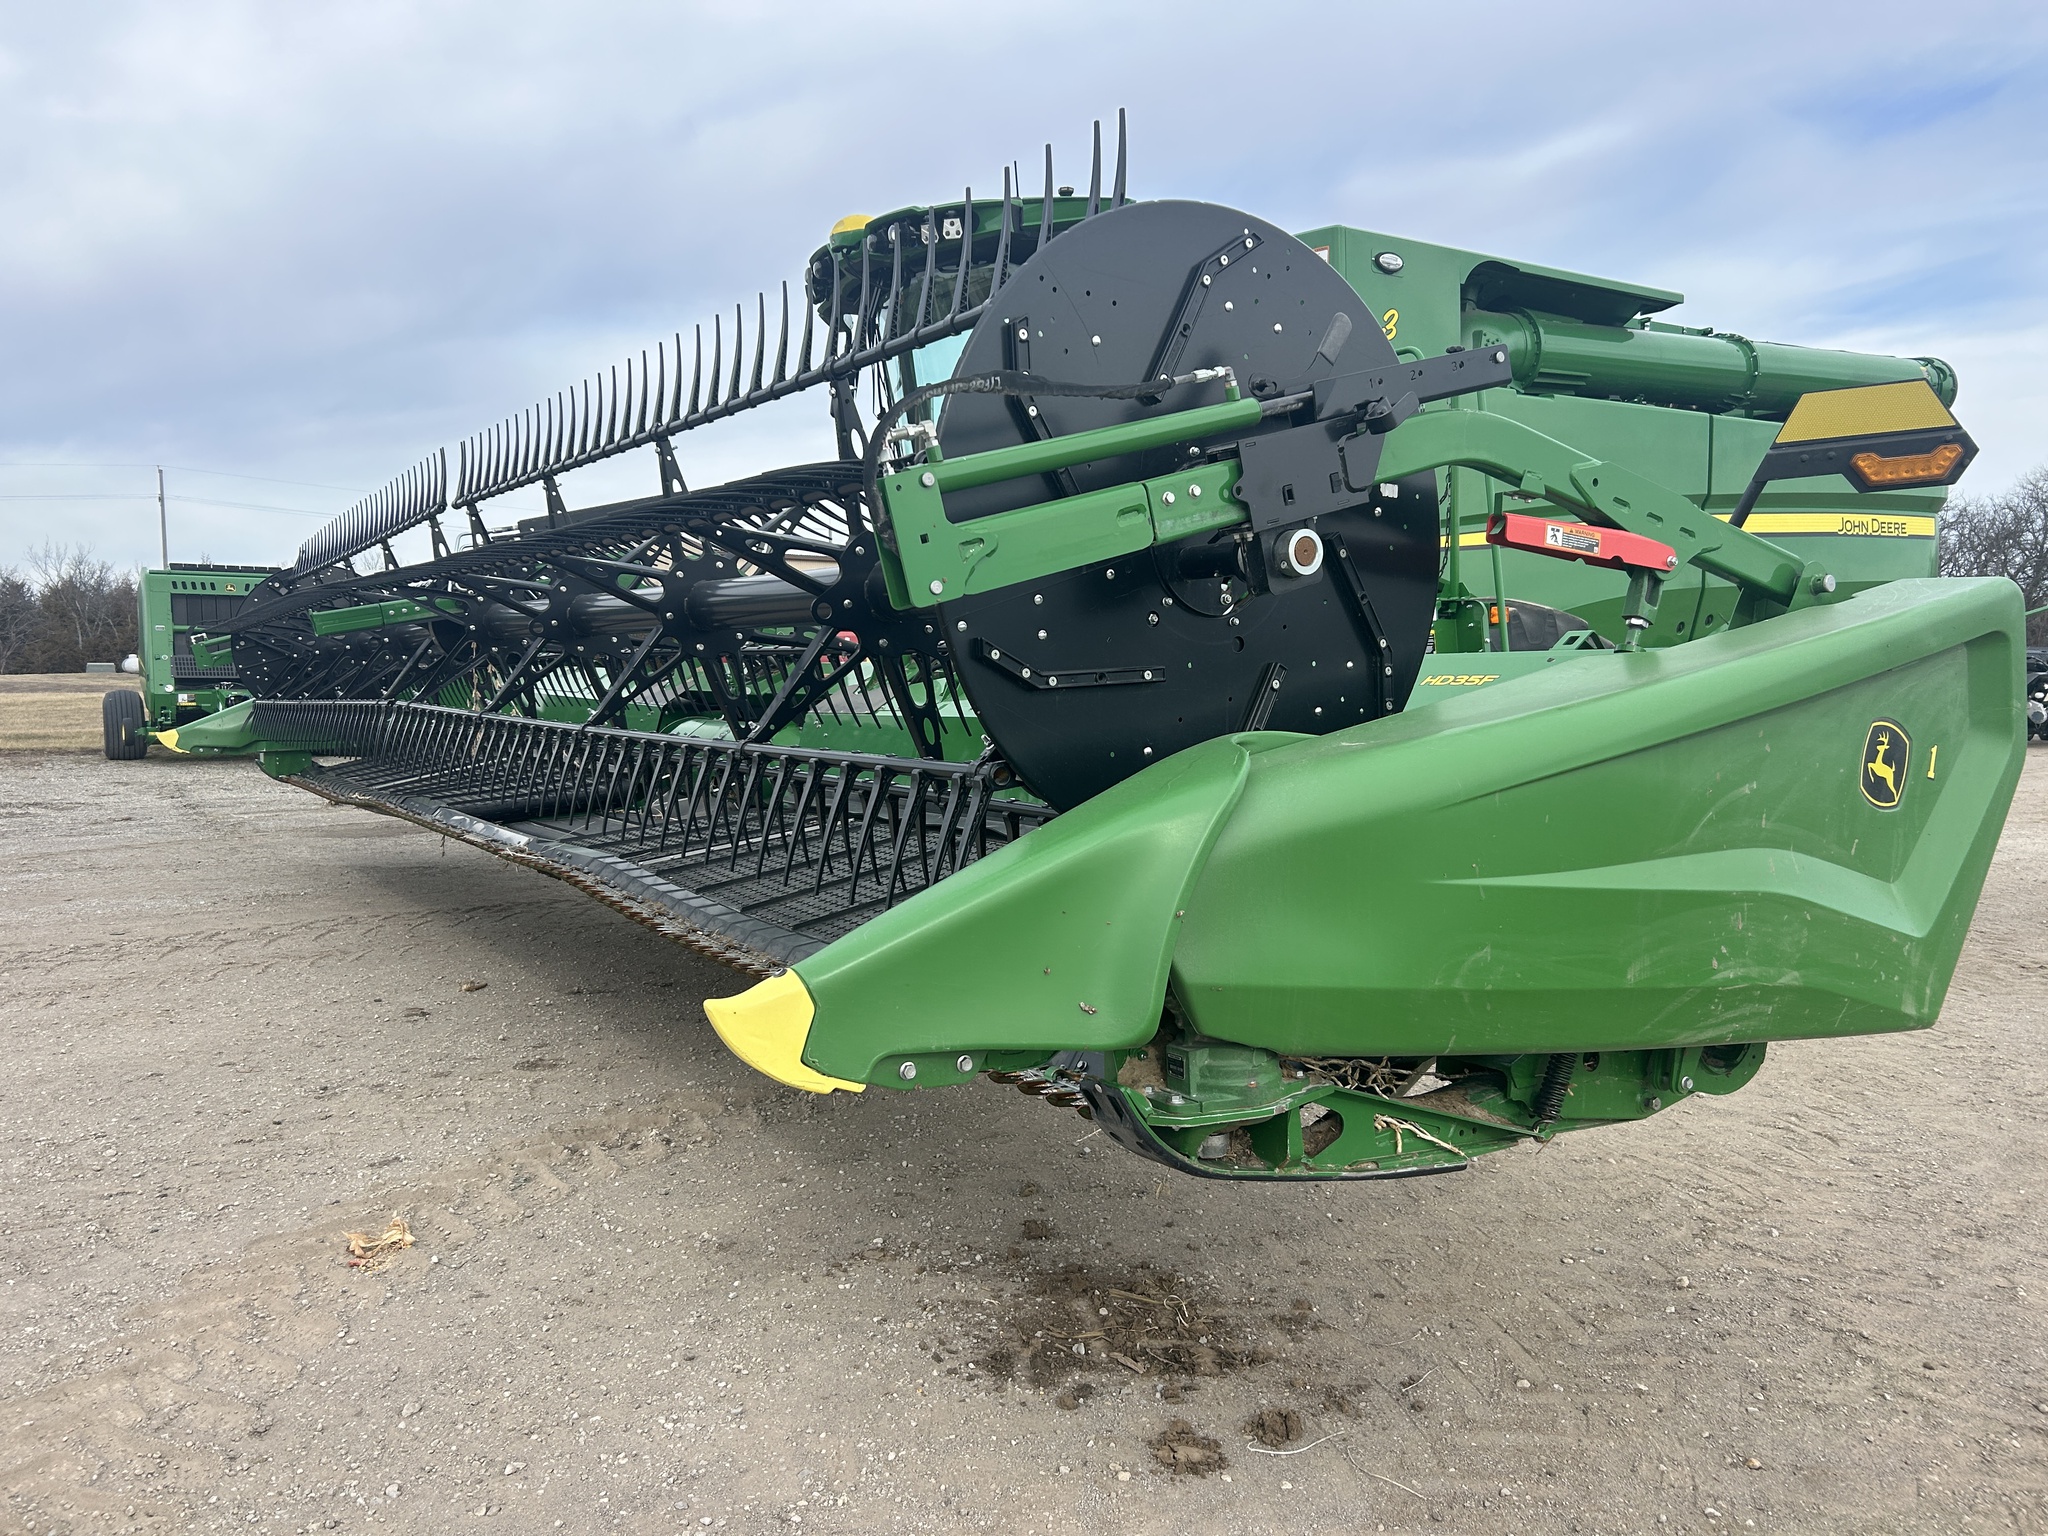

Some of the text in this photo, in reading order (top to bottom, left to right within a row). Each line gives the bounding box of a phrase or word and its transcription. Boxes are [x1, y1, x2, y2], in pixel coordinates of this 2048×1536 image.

[1369, 378, 1374, 389] 1
[1410, 369, 1417, 380] 2
[1451, 360, 1458, 371] 3
[1574, 529, 1595, 537] WARNING
[1838, 517, 1907, 534] JOHN DEERE
[1420, 674, 1500, 686] HD35F
[1927, 744, 1938, 780] 1
